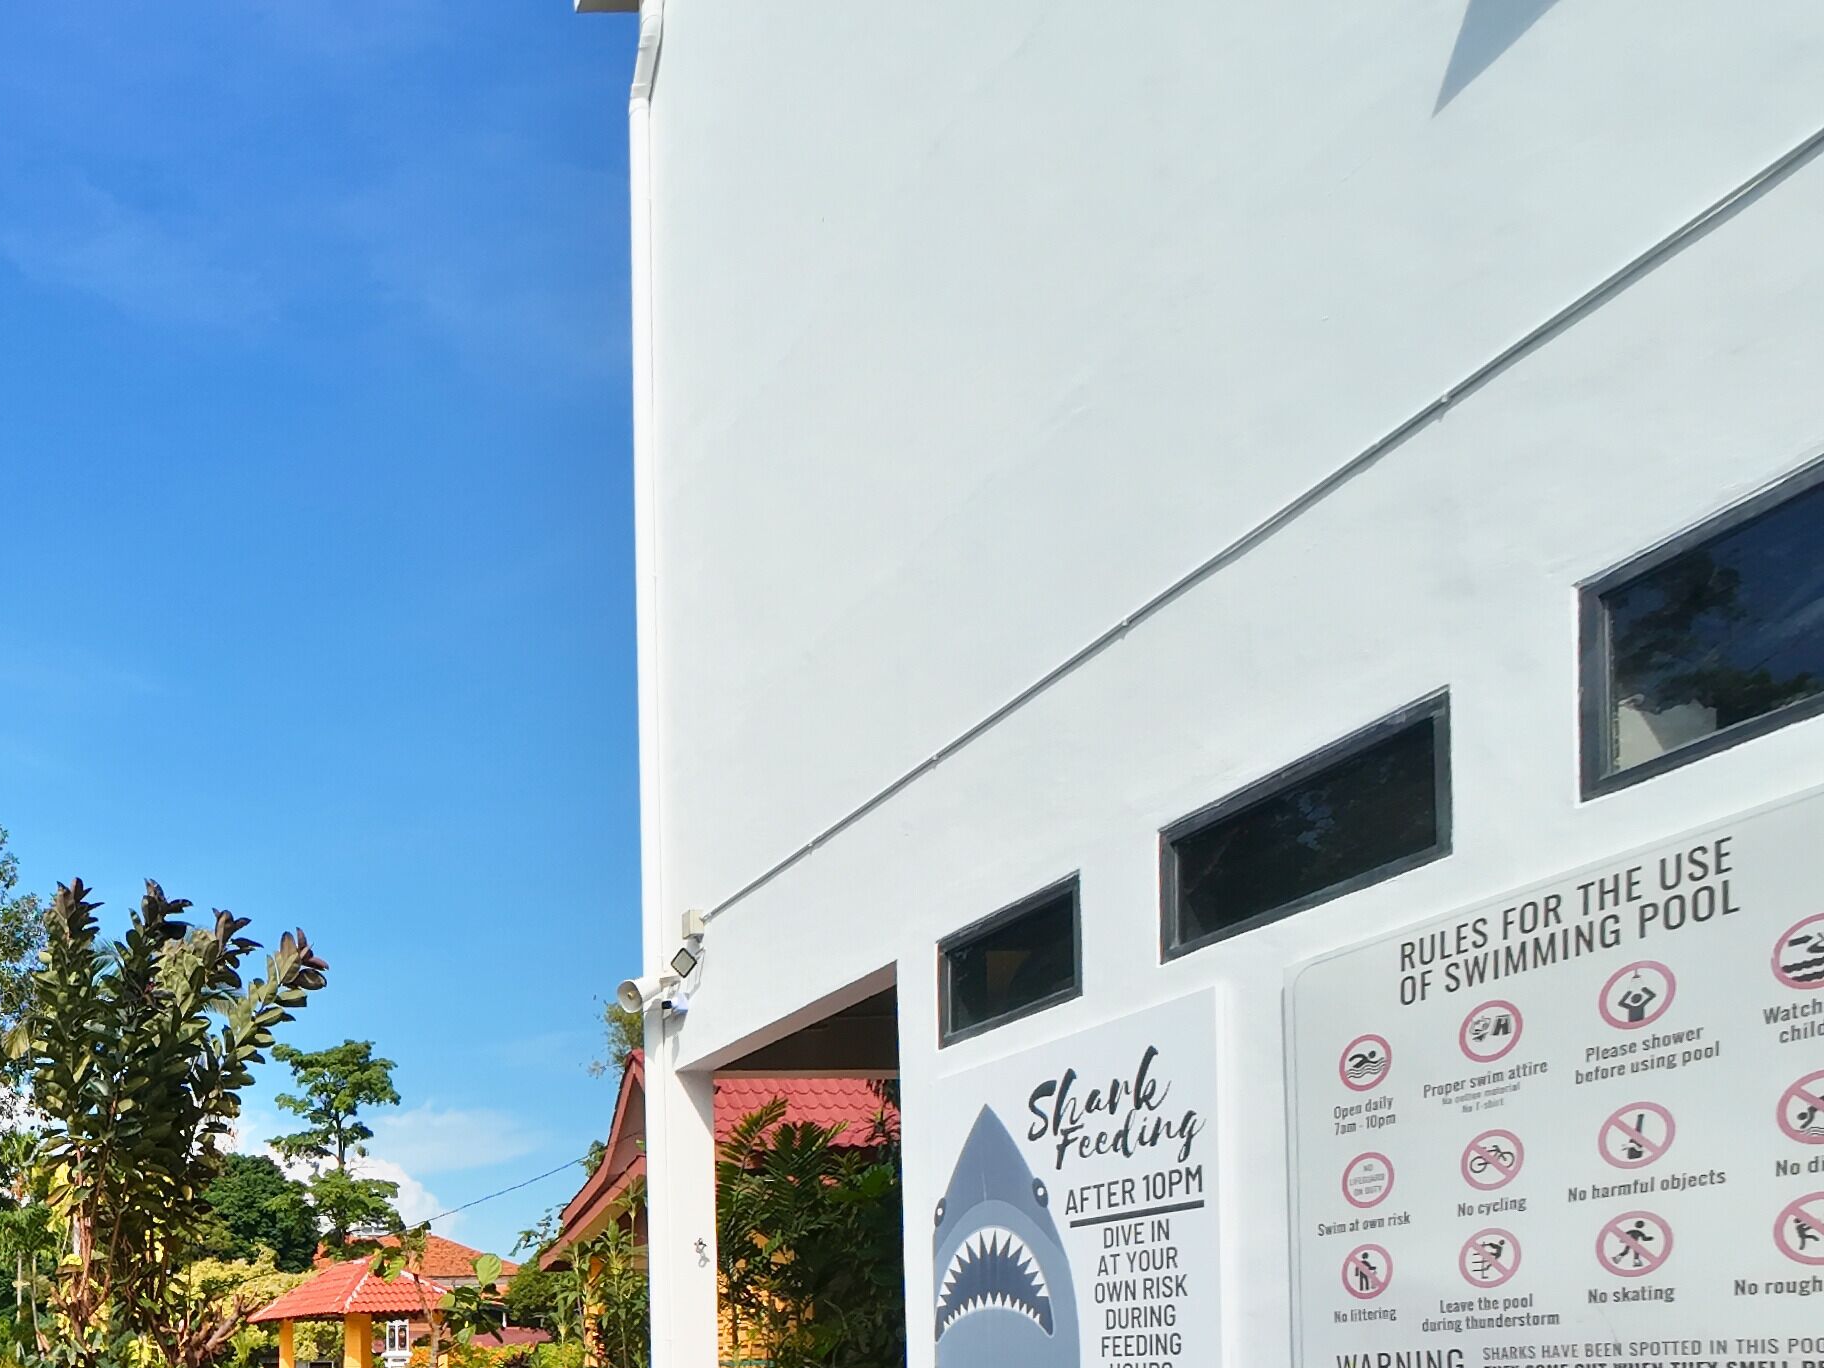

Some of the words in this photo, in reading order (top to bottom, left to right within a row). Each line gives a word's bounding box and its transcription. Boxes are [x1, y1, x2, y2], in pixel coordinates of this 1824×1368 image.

[1400, 917, 1488, 972] RULES
[1502, 893, 1562, 941] FOR
[1576, 865, 1643, 917] THE
[1659, 836, 1733, 891] USE
[1399, 970, 1432, 1006] OF
[1444, 914, 1621, 993] SWIMMING
[1638, 880, 1741, 939] POOL
[1762, 997, 1823, 1025] Watch
[1585, 1040, 1637, 1063] Please
[1642, 1027, 1704, 1052] shower
[1575, 1063, 1626, 1085] before
[1630, 1052, 1677, 1074] using
[1681, 1041, 1720, 1066] pool
[1027, 1045, 1172, 1142] Shark
[1423, 1079, 1466, 1099] Proper
[1469, 1070, 1505, 1089] swim
[1508, 1061, 1549, 1080] attire
[1333, 1103, 1362, 1120] Open
[1365, 1096, 1393, 1113] daily
[1334, 1121, 1356, 1136] 7am
[1365, 1113, 1396, 1131] 10pm
[1055, 1108, 1207, 1171] Feeding
[1776, 1159, 1800, 1177] No
[1065, 1178, 1136, 1216] AFTER
[1142, 1165, 1204, 1202] 10PM
[1568, 1186, 1587, 1202] No
[1591, 1176, 1655, 1200] harmful
[1660, 1169, 1727, 1192] objects
[1457, 1203, 1473, 1217] No
[1477, 1197, 1527, 1216] cycling
[1103, 1222, 1145, 1249] DIVE
[1151, 1218, 1170, 1242] IN
[1318, 1221, 1346, 1236] Swim
[1349, 1219, 1359, 1232] at
[1362, 1218, 1384, 1230] own
[1388, 1211, 1411, 1226] risk
[1097, 1253, 1120, 1277] AT
[1126, 1246, 1179, 1273] YOUR
[1094, 1279, 1137, 1304] OWN
[1143, 1273, 1188, 1300] RISK
[1588, 1288, 1607, 1304] No
[1613, 1285, 1676, 1303] skating
[1733, 1278, 1758, 1296] No
[1765, 1275, 1823, 1296] rough
[1105, 1303, 1176, 1330] DURING
[1334, 1310, 1347, 1324] No
[1350, 1307, 1396, 1322] littering
[1439, 1299, 1474, 1314] Leave
[1478, 1296, 1499, 1311] the
[1502, 1293, 1534, 1313] pool
[1422, 1318, 1462, 1332] during
[1465, 1312, 1560, 1330] thunderstorm
[1101, 1332, 1182, 1358] FEEDING
[1482, 1345, 1537, 1361] SHARKS
[1541, 1343, 1578, 1360] HAVE
[1585, 1342, 1622, 1358] BEEN
[1629, 1340, 1702, 1357] SPOTTED
[1710, 1339, 1727, 1355] IN
[1736, 1338, 1779, 1354] THIS
